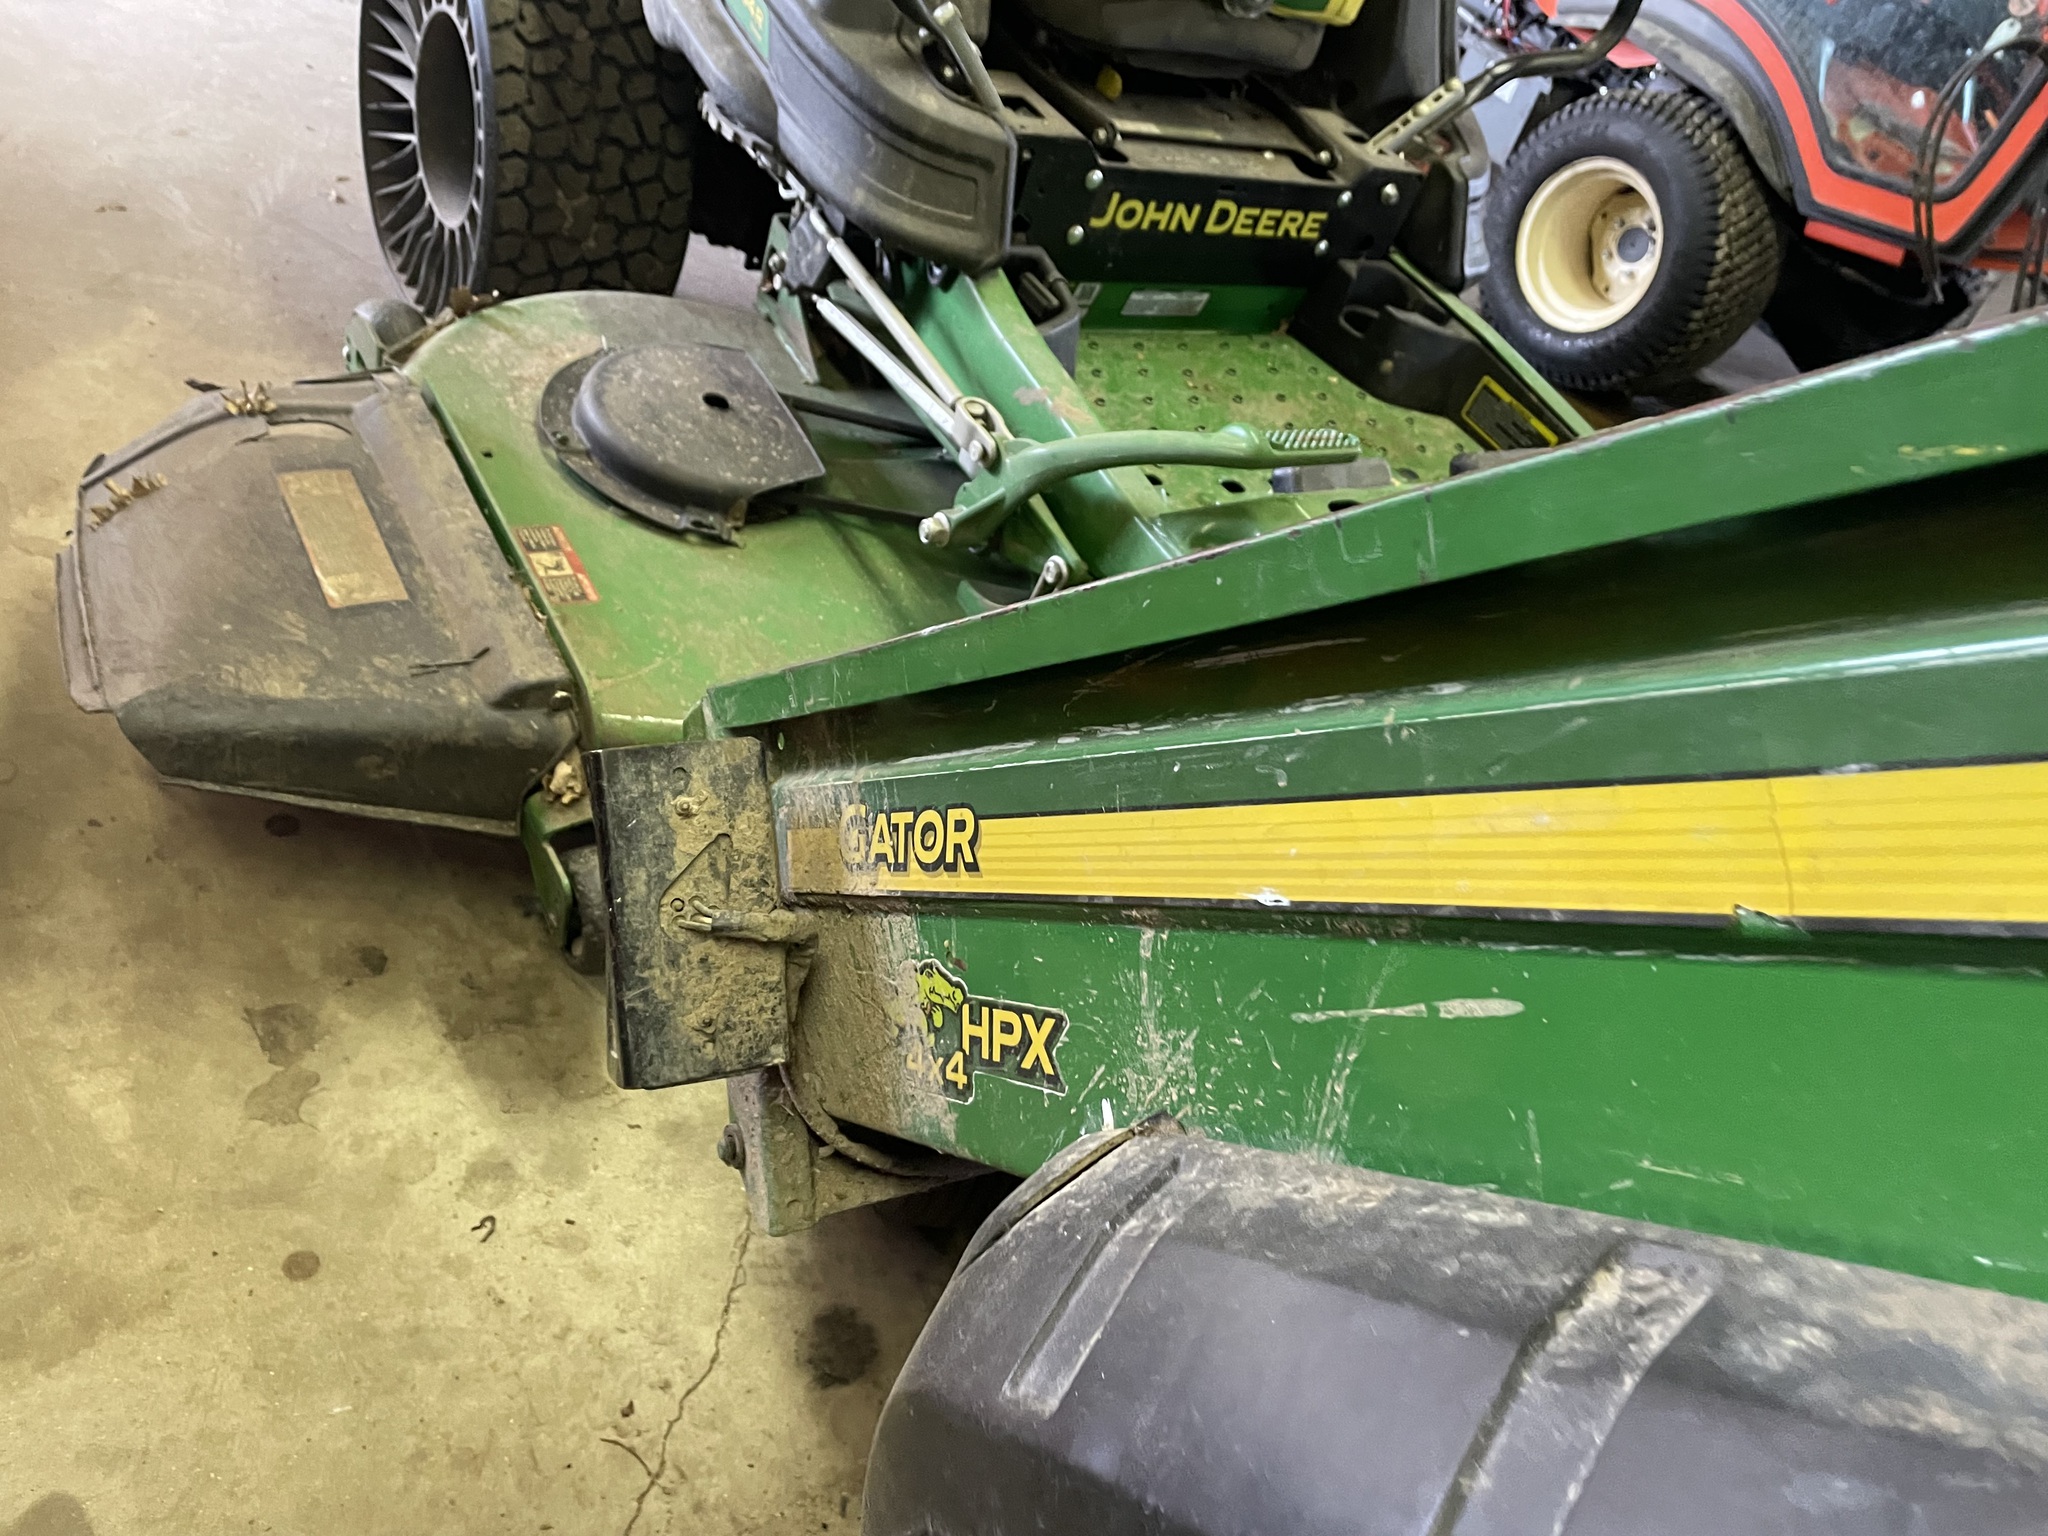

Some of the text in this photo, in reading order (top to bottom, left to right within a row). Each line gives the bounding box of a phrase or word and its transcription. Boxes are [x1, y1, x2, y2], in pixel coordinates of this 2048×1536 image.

[1089, 191, 1328, 239] JOHN DEERE
[840, 802, 980, 873] GATOR
[962, 1003, 1056, 1076] HPX
